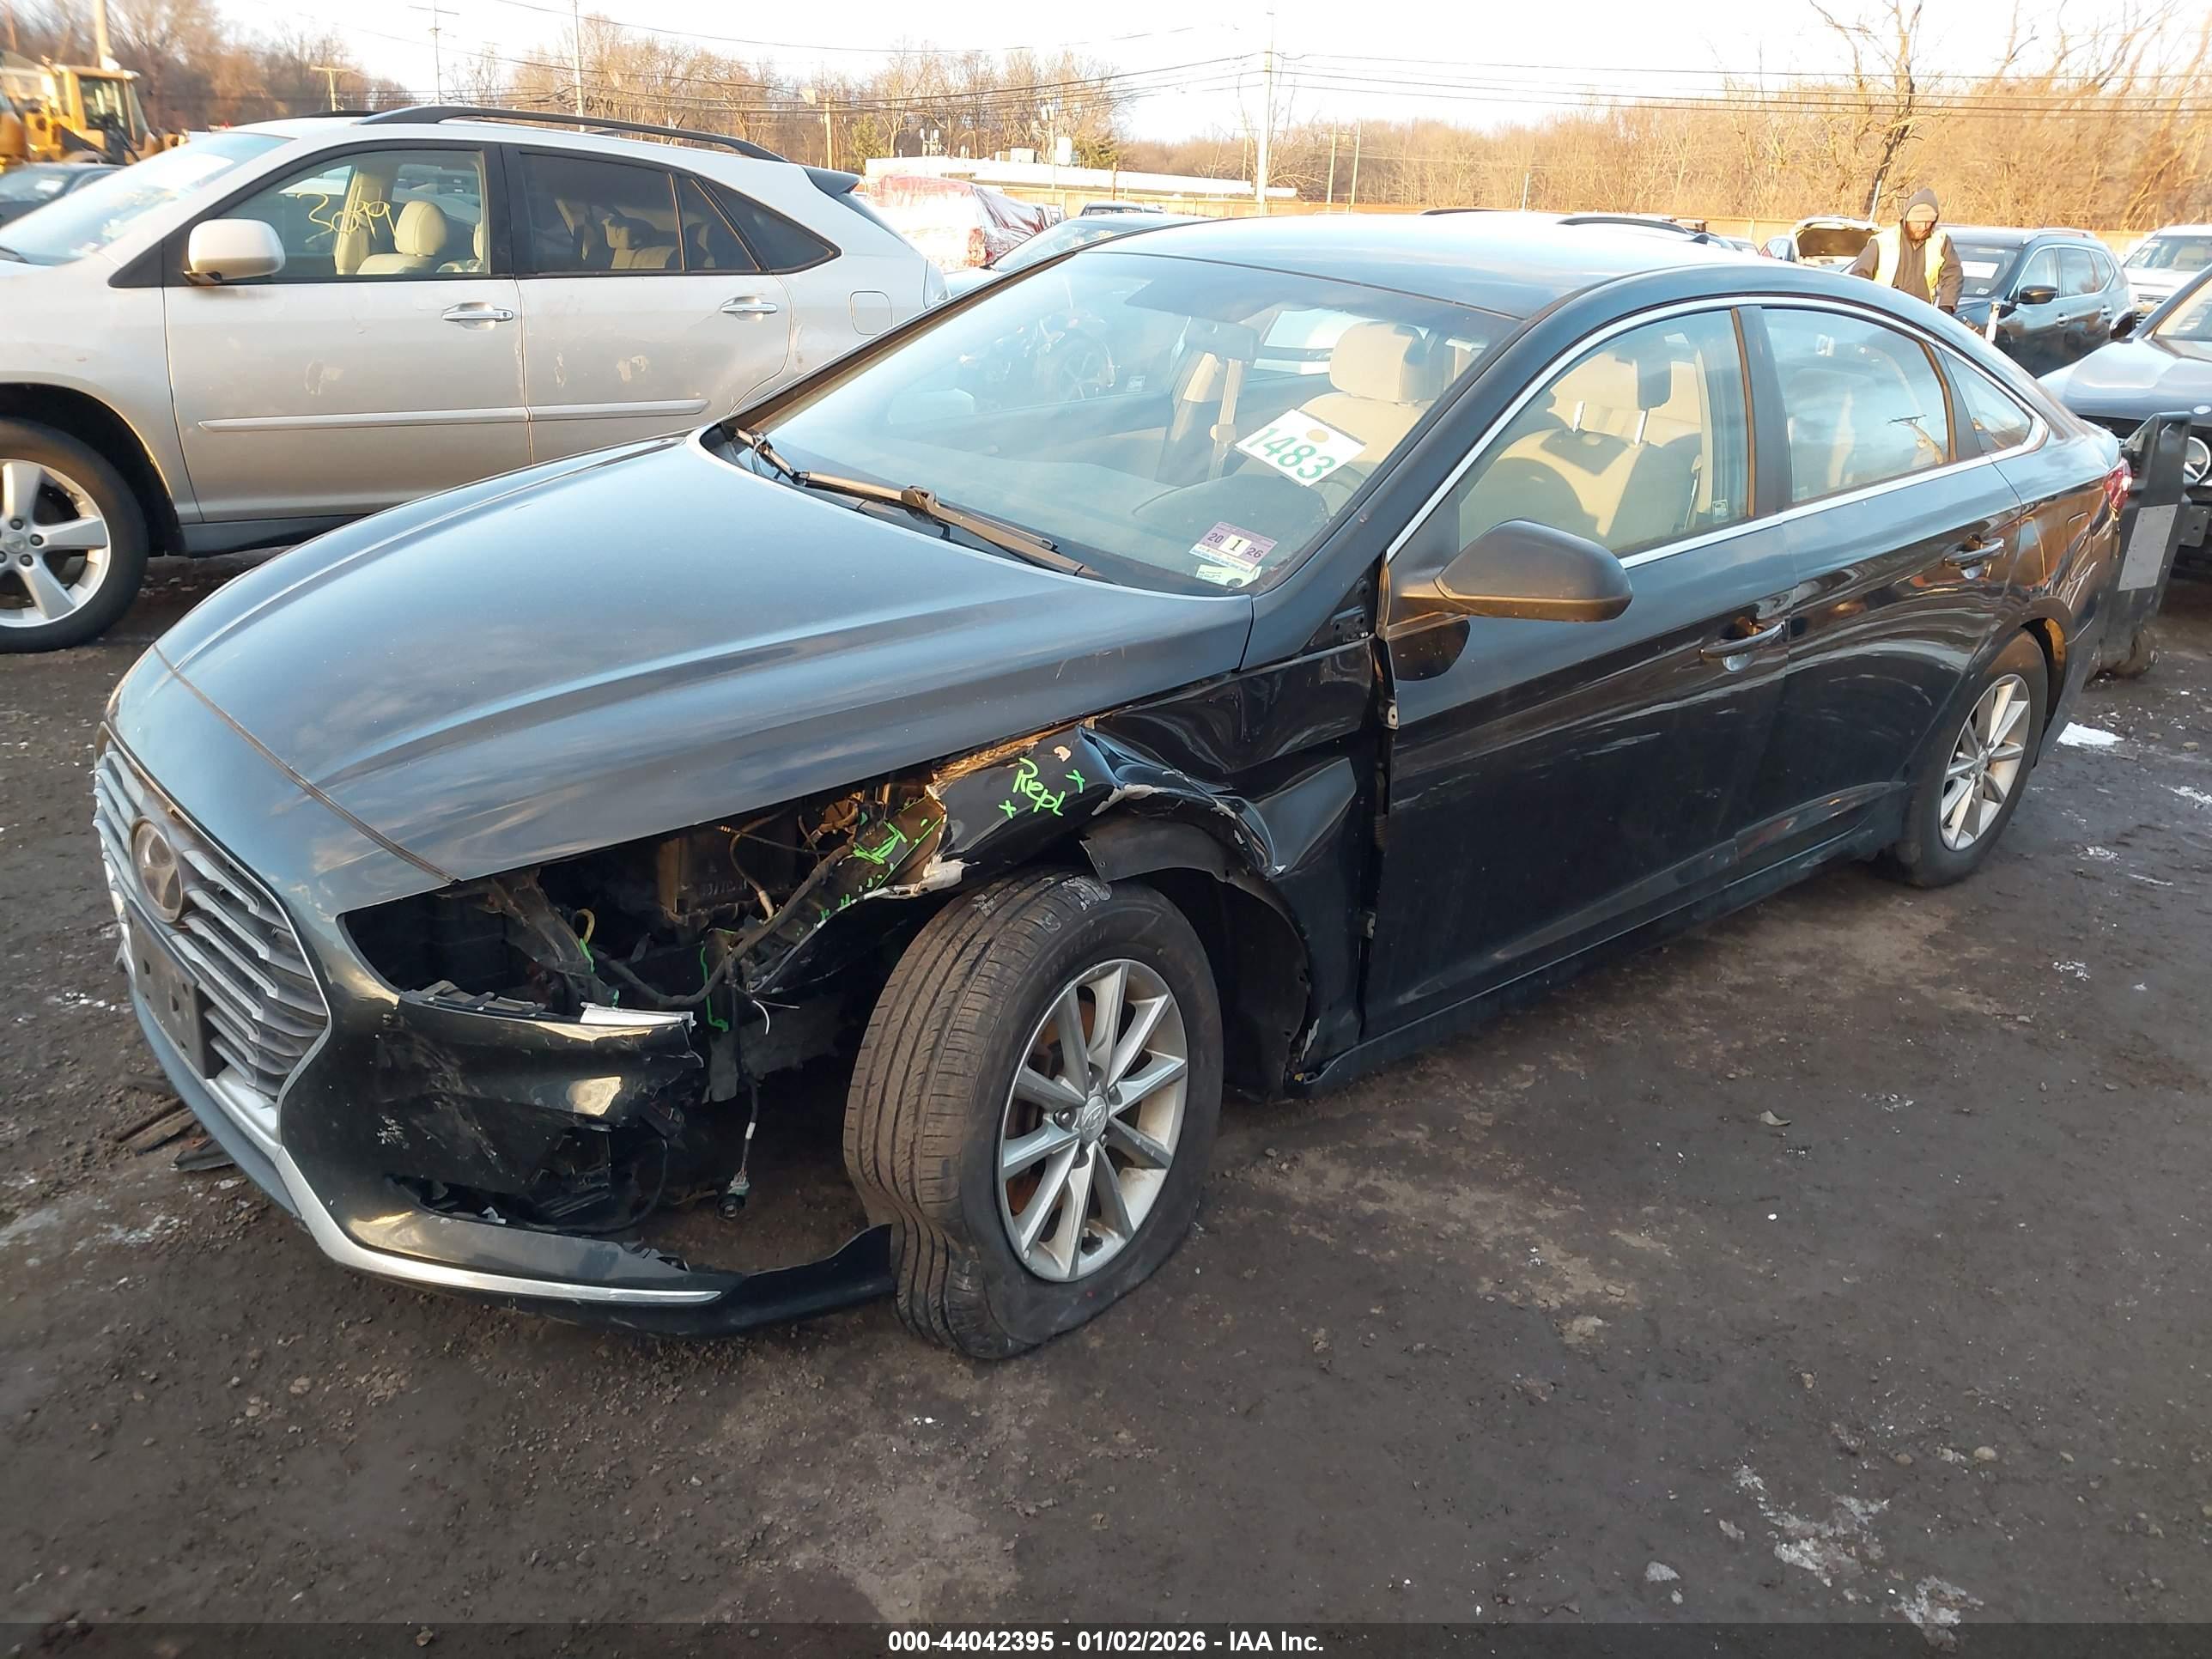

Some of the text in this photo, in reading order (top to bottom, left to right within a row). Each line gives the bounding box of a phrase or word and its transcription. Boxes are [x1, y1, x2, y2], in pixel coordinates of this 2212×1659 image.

[1247, 428, 1336, 479] 1483
[1207, 532, 1224, 544] 20
[1230, 539, 1243, 551] 1
[1246, 547, 1264, 558] 26
